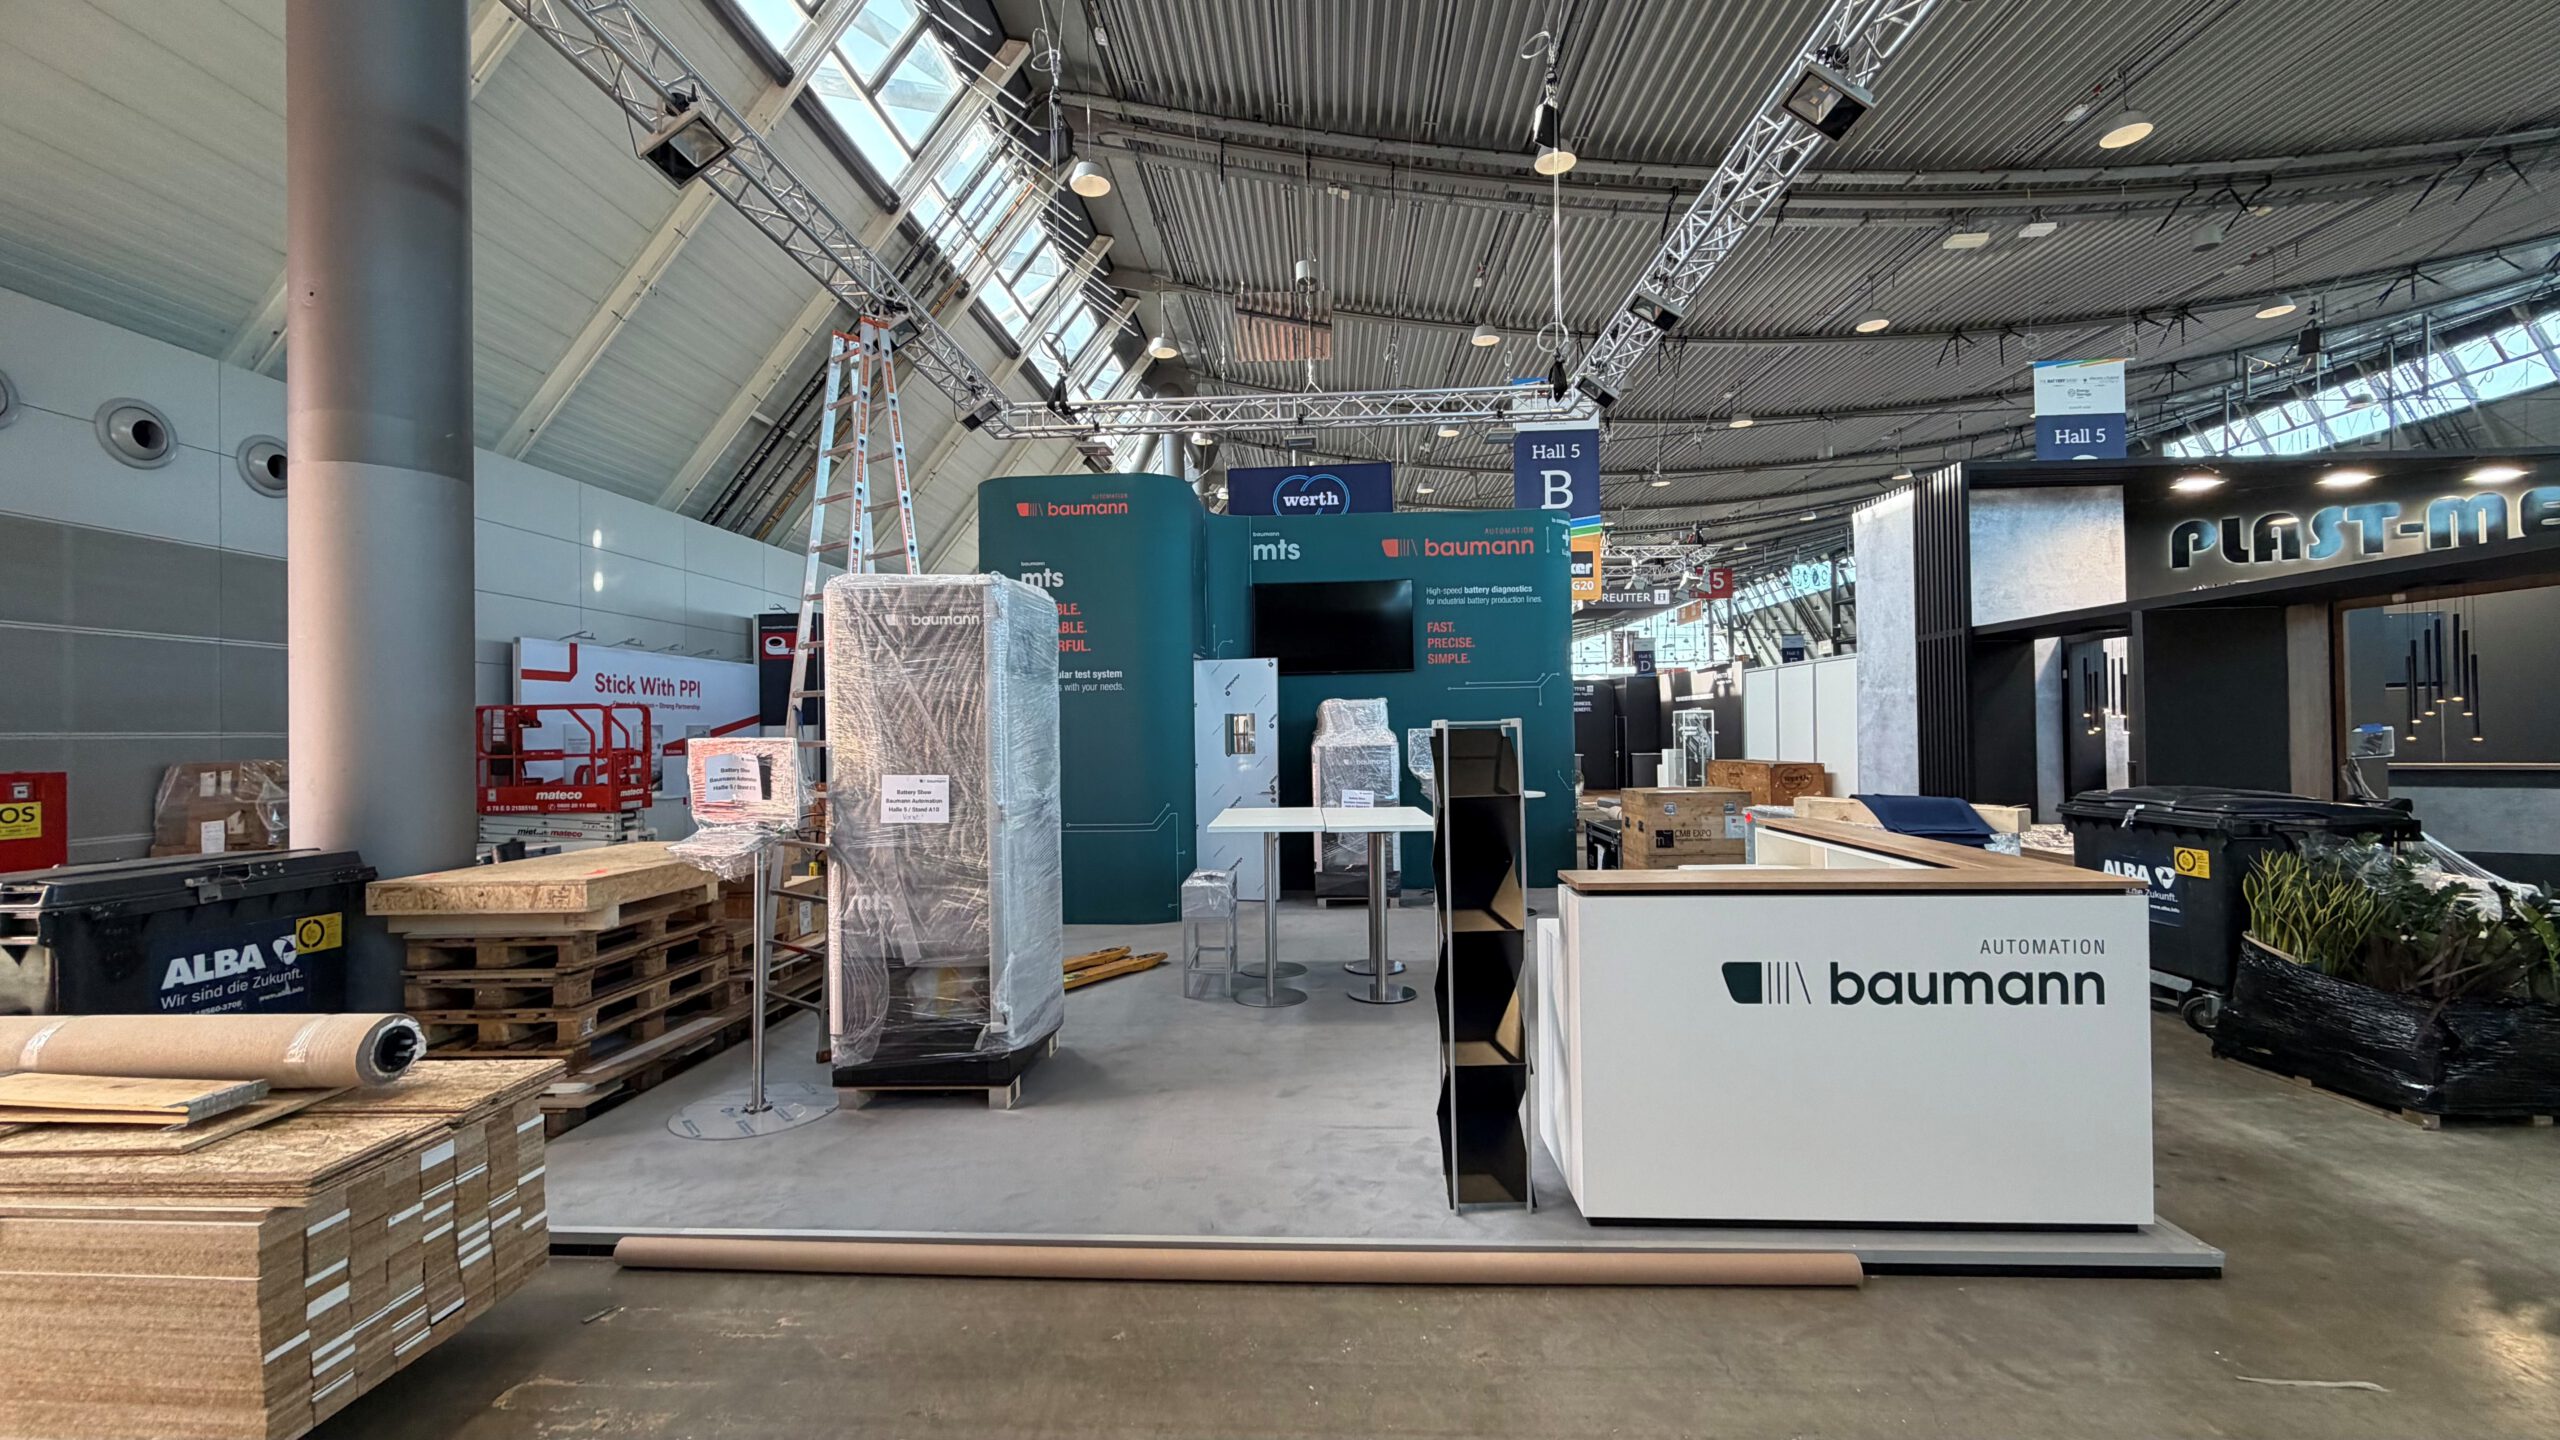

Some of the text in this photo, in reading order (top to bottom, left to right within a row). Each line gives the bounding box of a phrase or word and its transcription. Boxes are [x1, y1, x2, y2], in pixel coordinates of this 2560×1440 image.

[2054, 427, 2106, 445] Hall 5
[1531, 443, 1581, 460] Hall 5
[1539, 469, 1574, 510] B
[1282, 491, 1340, 507] werth
[1047, 502, 1128, 516] baumann
[1484, 526, 1534, 535] AUTOMATION
[1252, 539, 1301, 561] mts
[1424, 538, 1534, 557] baumann
[1021, 568, 1064, 588] mts
[1712, 571, 1725, 590] 5
[1426, 584, 1533, 597] High-speed battery diagnostics
[1571, 580, 1594, 591] G20
[1426, 597, 1436, 606] for
[1437, 596, 1466, 605] industrial
[1467, 596, 1490, 605] battery
[1491, 595, 1520, 605] production
[1602, 592, 1651, 603] REUTTER
[912, 614, 980, 626] baumann
[1426, 621, 1456, 633] FAST.
[1427, 636, 1476, 649] PRECISE.
[1427, 652, 1472, 665] SIMPLE.
[1639, 660, 1651, 672] D
[1075, 669, 1091, 679] test
[1092, 669, 1123, 681] system
[594, 672, 701, 699] Stick With PPI
[1064, 682, 1080, 692] with
[1081, 683, 1098, 694] your
[1100, 681, 1126, 692] needs.
[535, 788, 644, 800] mateco mateco
[550, 829, 583, 838] mateco
[2103, 858, 2152, 885] ALBA
[1980, 938, 2106, 956] AUTOMATION
[160, 943, 267, 991] ALBA
[160, 967, 304, 1010] Wir sind die Zukunft.
[1830, 961, 2106, 1006] baumann
